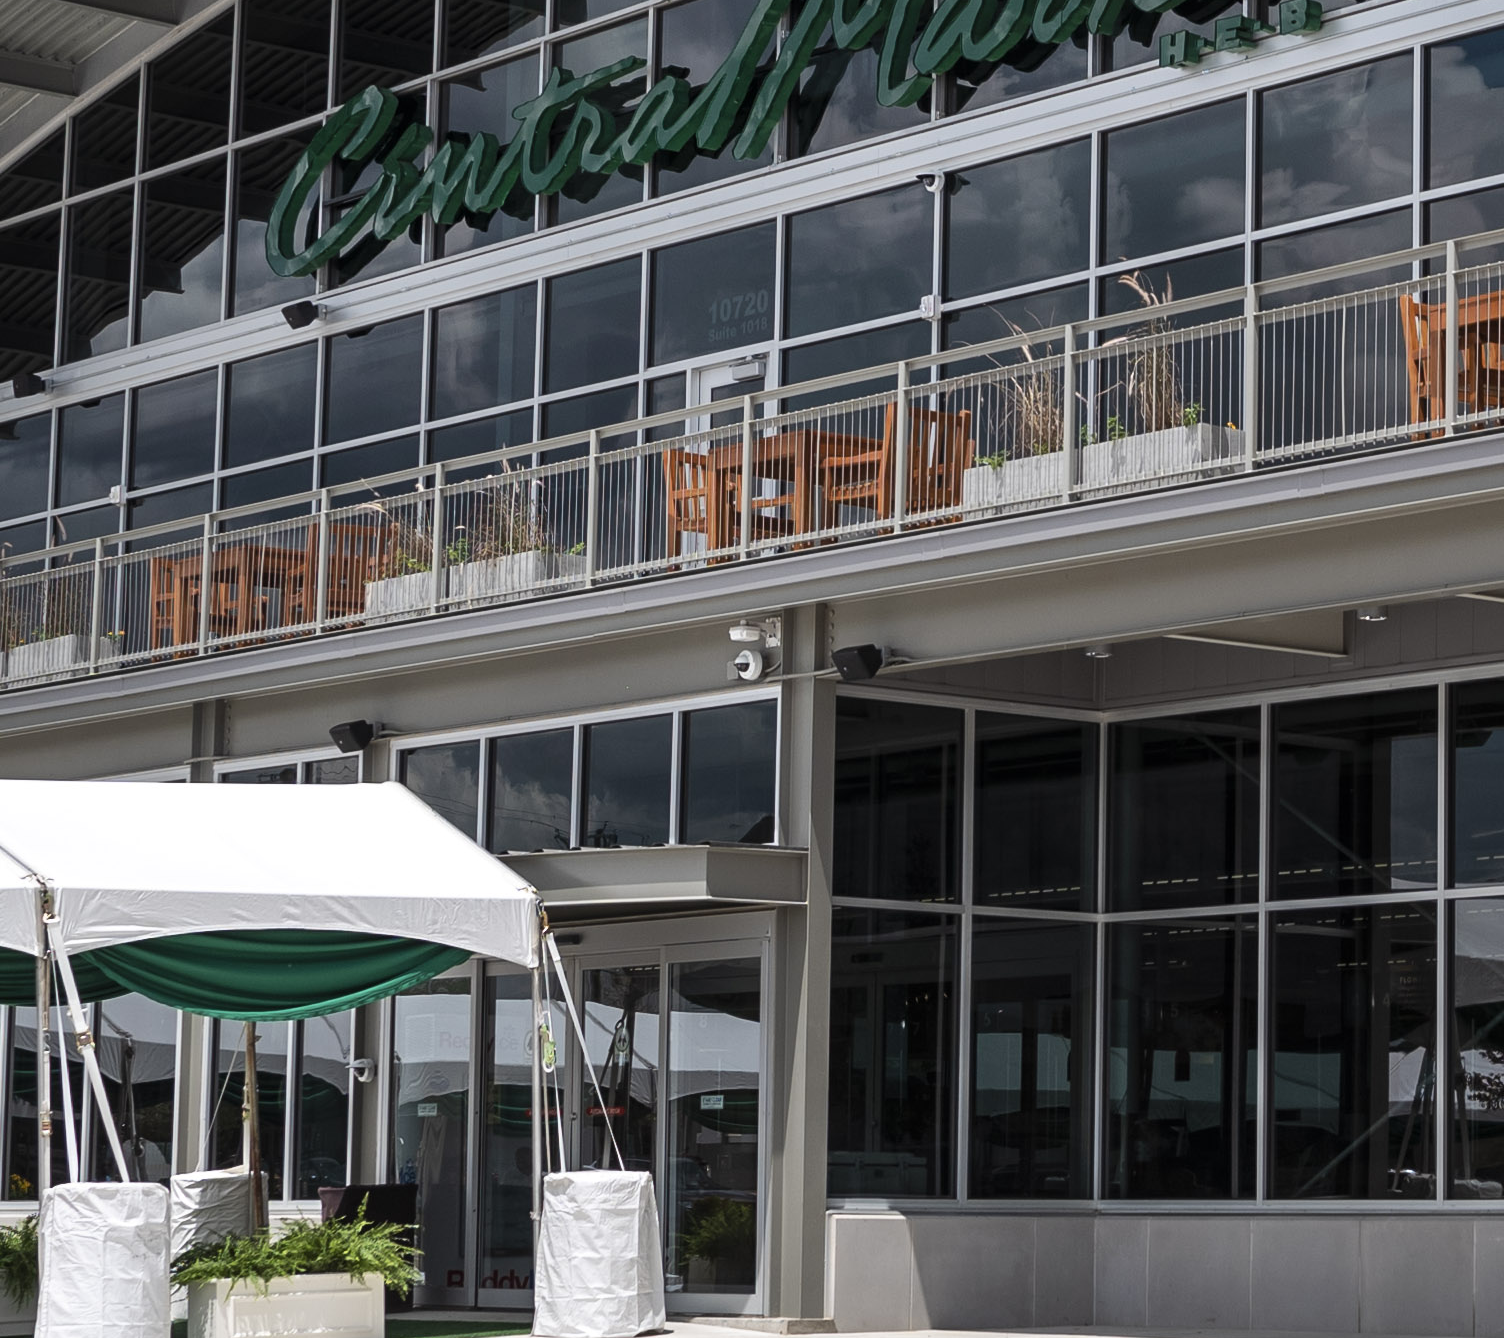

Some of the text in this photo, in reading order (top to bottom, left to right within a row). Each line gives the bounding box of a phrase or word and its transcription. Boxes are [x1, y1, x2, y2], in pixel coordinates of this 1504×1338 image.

[707, 288, 769, 324] 10720
[707, 316, 769, 343] Suite 1018
